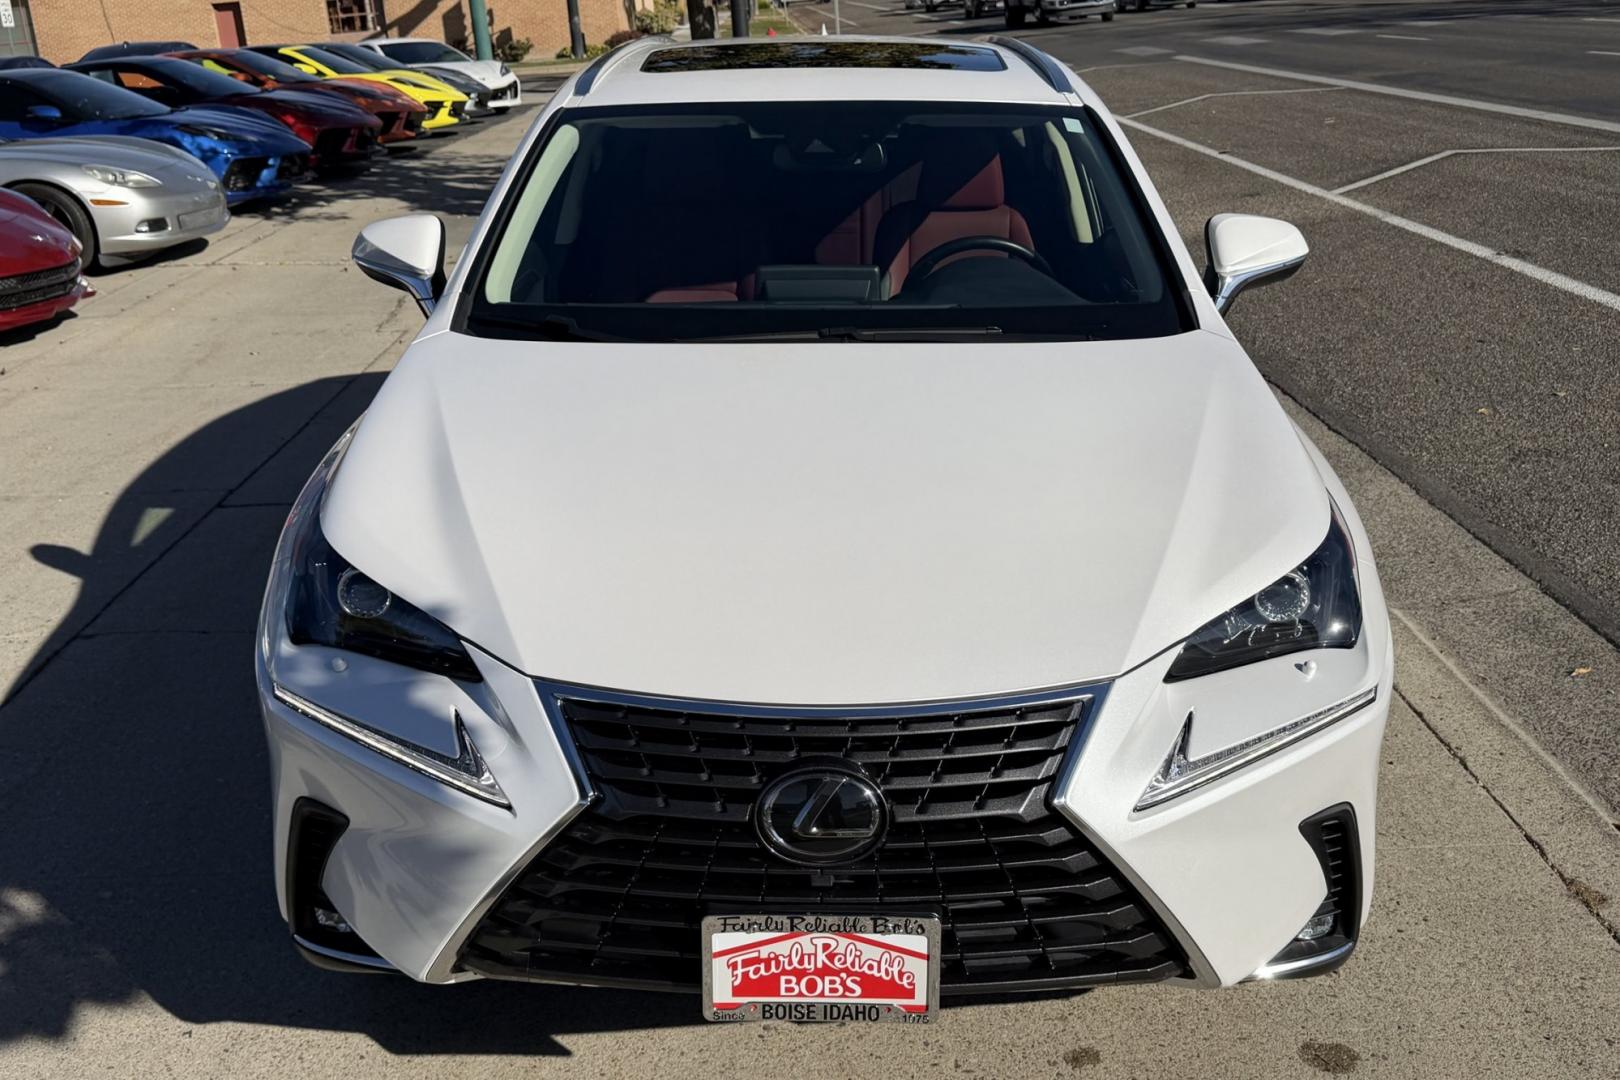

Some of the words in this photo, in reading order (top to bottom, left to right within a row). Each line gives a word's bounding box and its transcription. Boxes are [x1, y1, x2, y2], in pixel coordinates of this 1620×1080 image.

[717, 916, 784, 933] Fairly
[786, 916, 867, 933] Reliable
[727, 942, 815, 987] Fairly
[810, 936, 916, 989] Reliable
[779, 974, 863, 998] BOB'S
[713, 1010, 746, 1021] Since
[762, 1003, 817, 1020] BOISE
[824, 1004, 880, 1022] IDAHO
